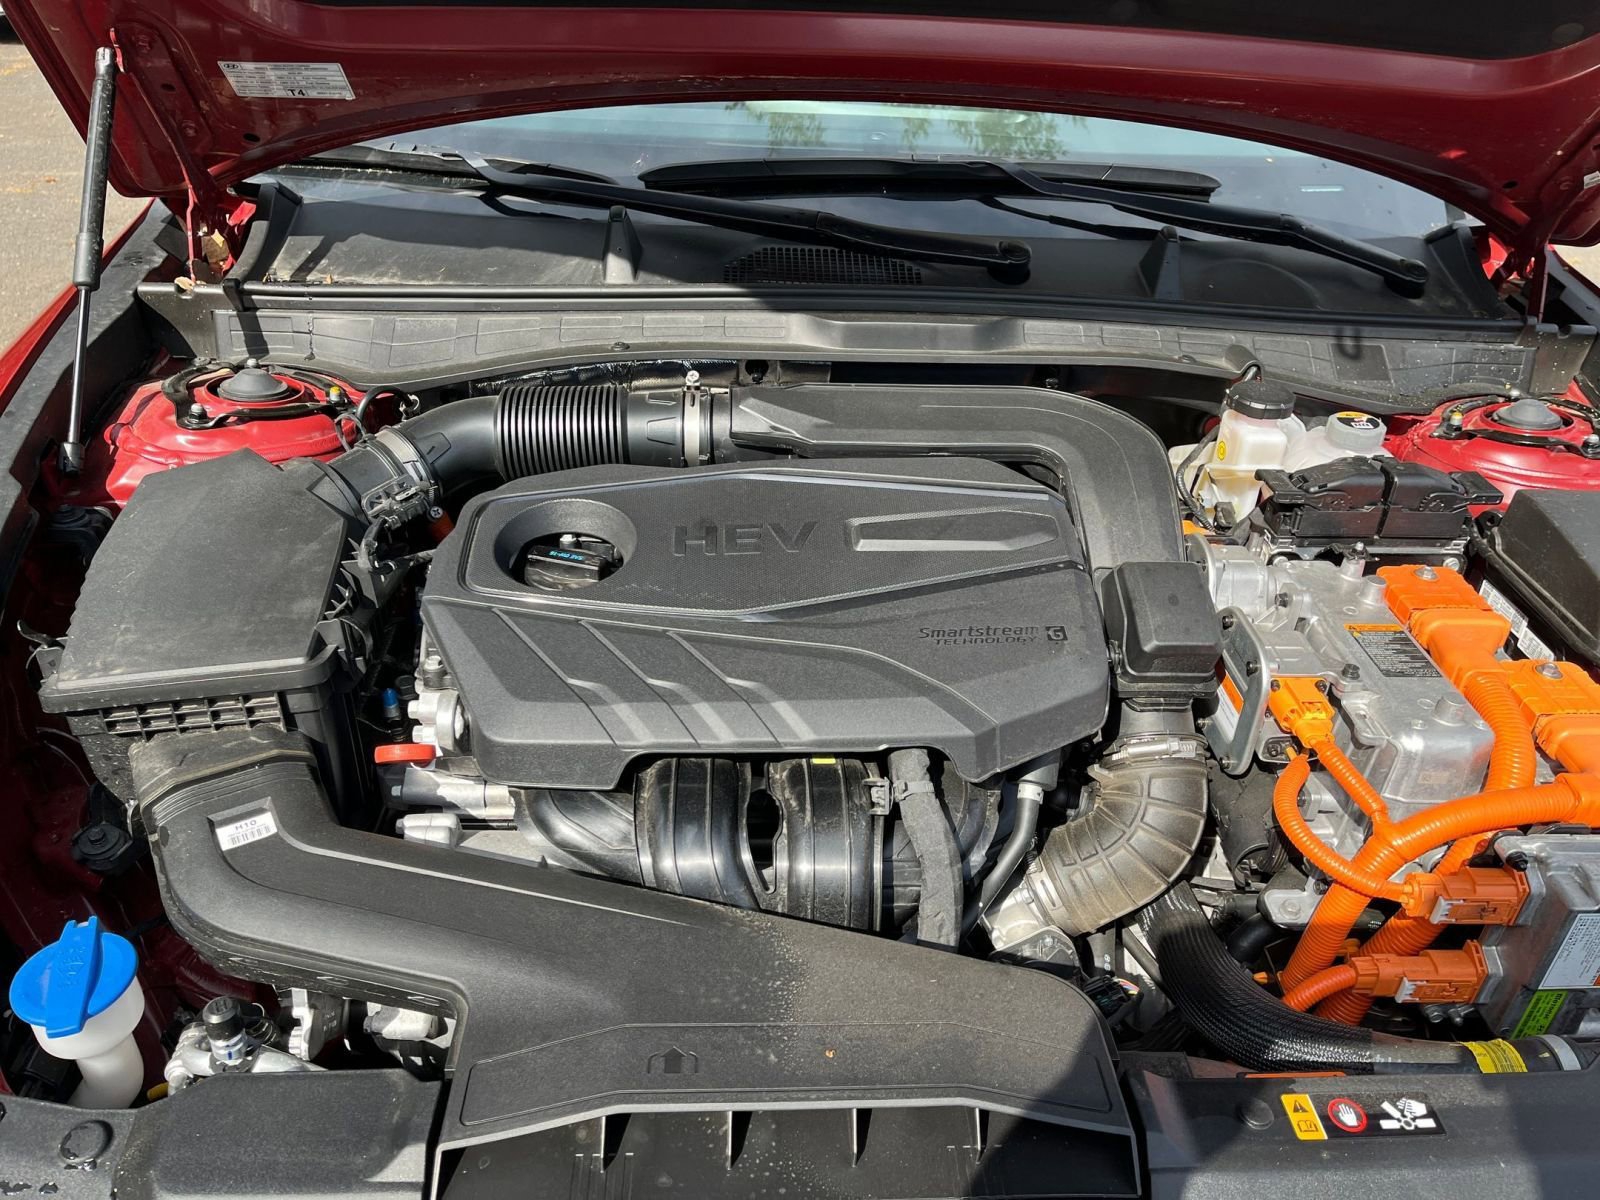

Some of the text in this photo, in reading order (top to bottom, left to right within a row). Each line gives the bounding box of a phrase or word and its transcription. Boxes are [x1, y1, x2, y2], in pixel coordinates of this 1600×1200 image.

[287, 88, 306, 97] T4
[672, 521, 818, 557] HEV
[918, 625, 1039, 640] Smartstream
[933, 636, 1038, 646] TECHNOLOGY
[235, 819, 257, 832] H10
